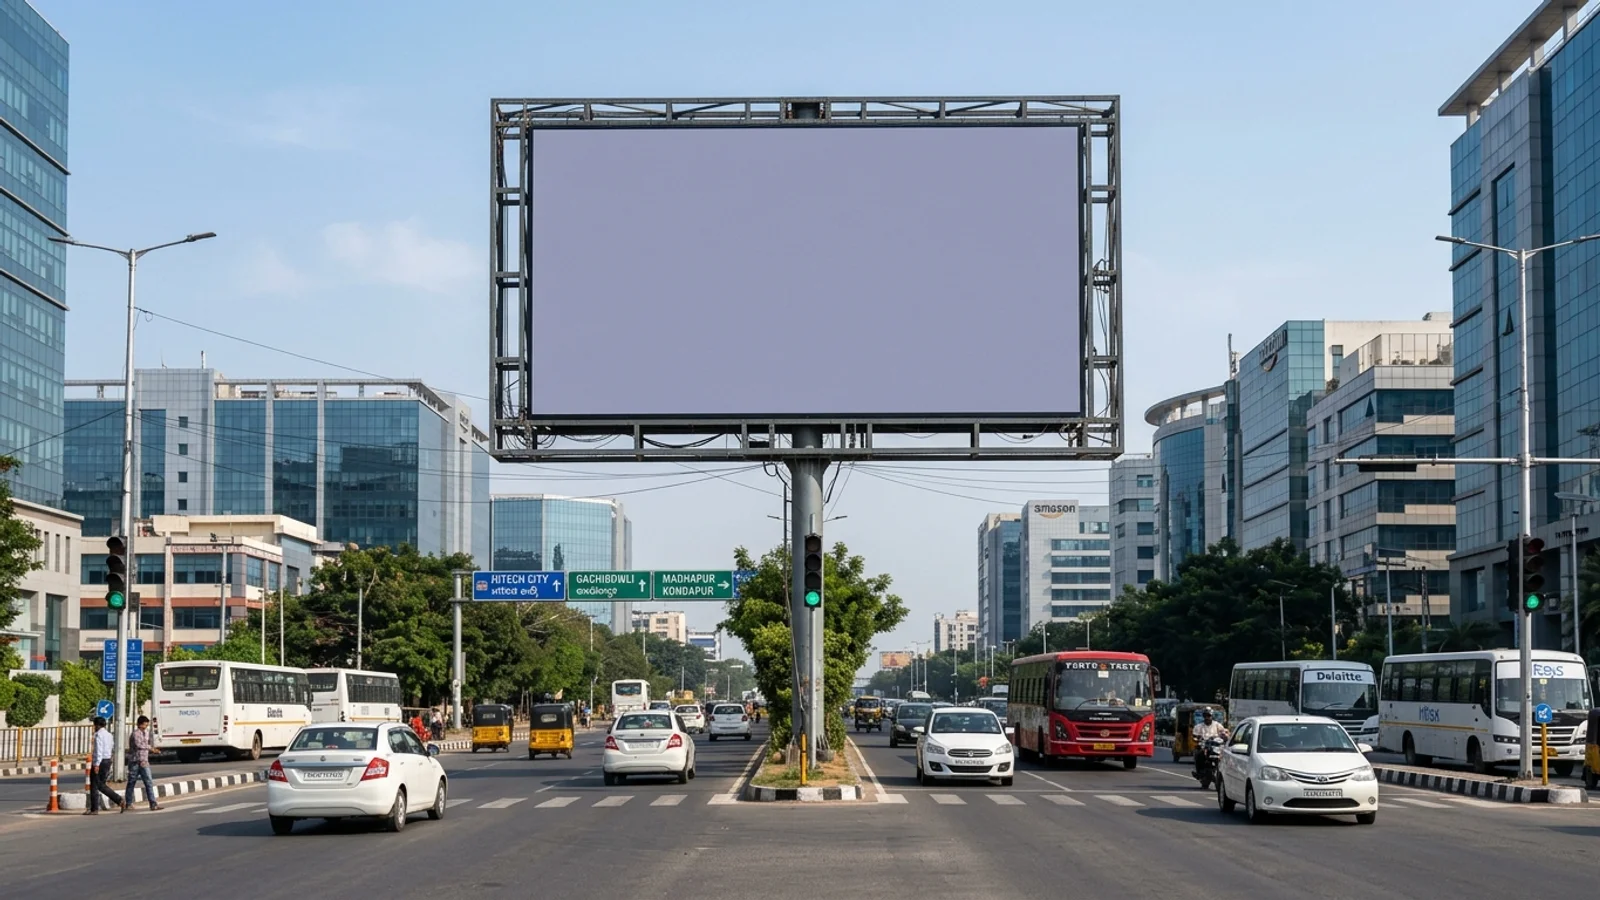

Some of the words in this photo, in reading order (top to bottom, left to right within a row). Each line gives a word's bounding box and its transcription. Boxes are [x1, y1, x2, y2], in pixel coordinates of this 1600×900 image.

[491, 574, 525, 584] HITECH
[527, 574, 549, 584] CITY
[662, 574, 715, 584] MADHAPUR
[662, 586, 714, 596] KONDAPUR
